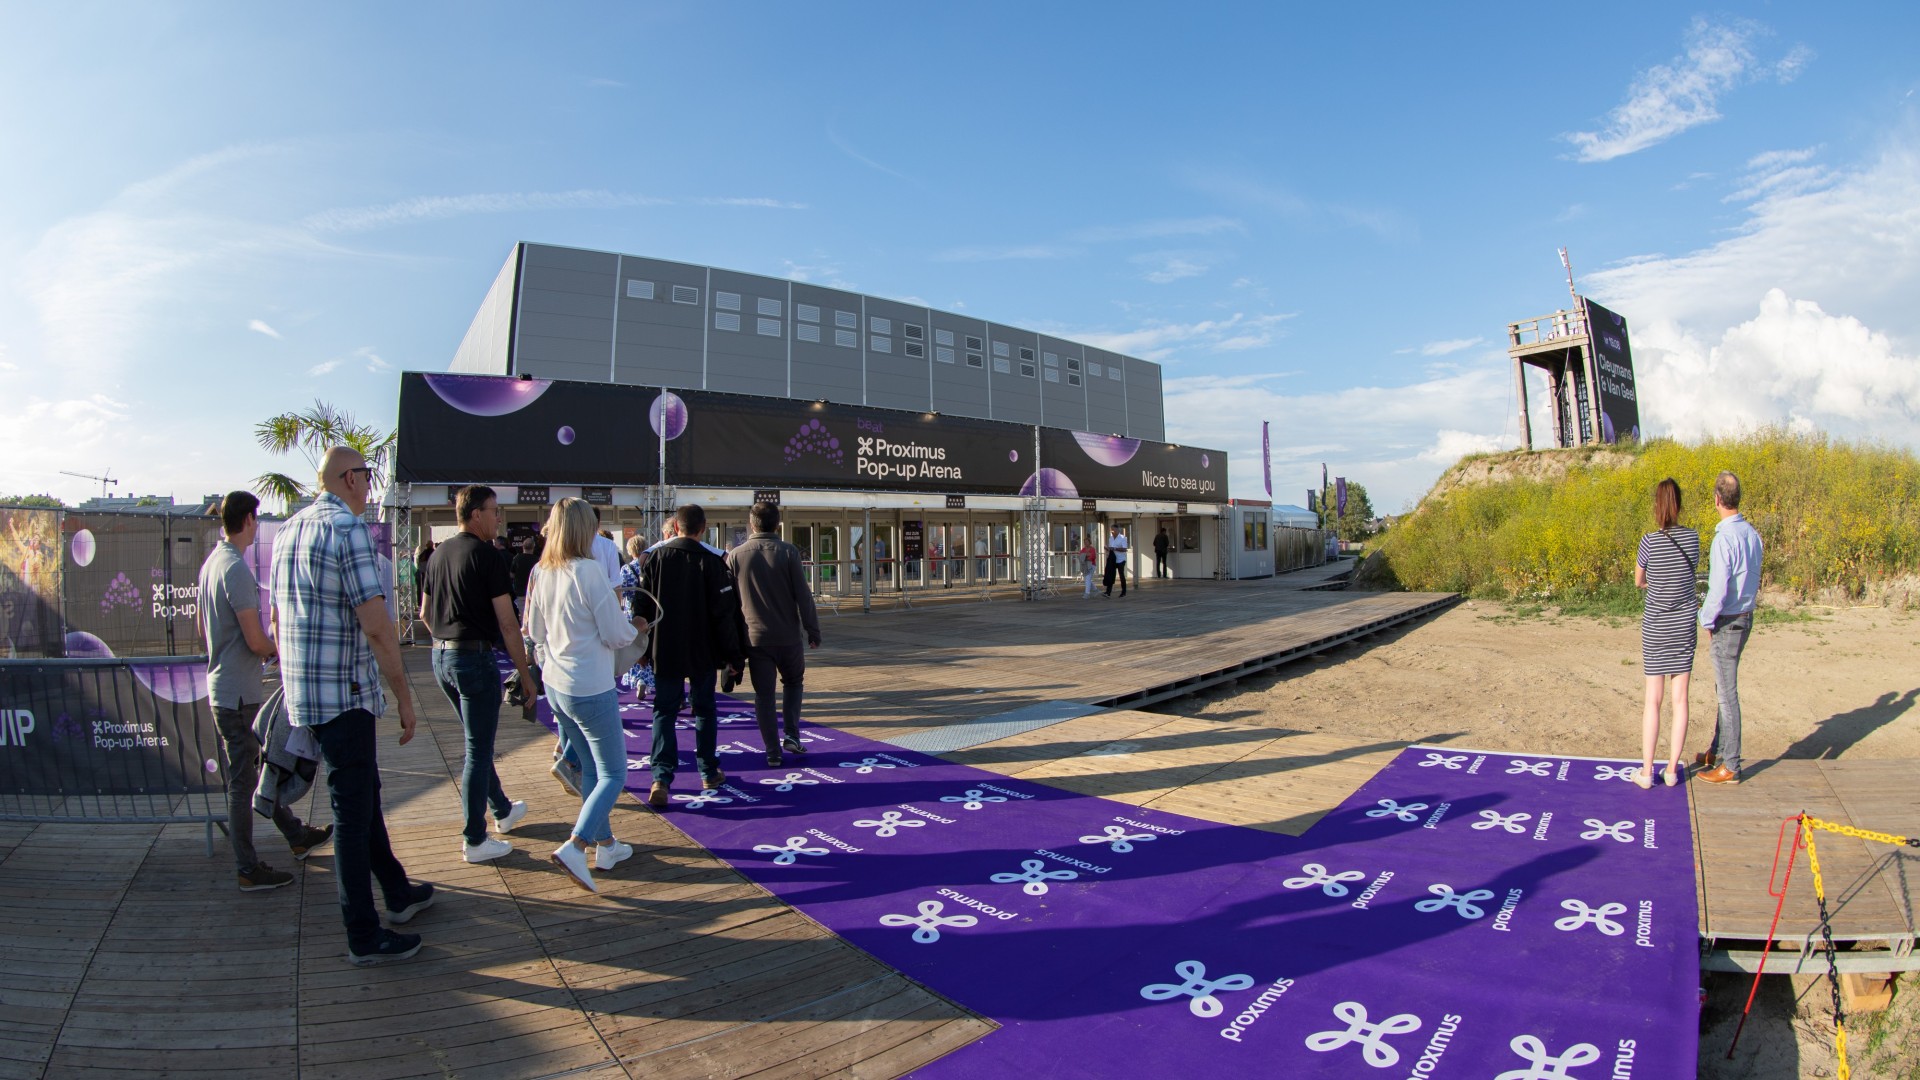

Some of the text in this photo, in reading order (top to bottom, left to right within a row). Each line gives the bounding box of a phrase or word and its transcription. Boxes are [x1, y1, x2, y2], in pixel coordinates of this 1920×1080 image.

[1599, 354, 1632, 380] Cleymans
[1600, 375, 1606, 392] &
[1607, 377, 1620, 396] Van
[857, 418, 884, 432] beat
[876, 438, 946, 460] Proximus
[857, 457, 962, 481] Pop-up Arena
[1142, 470, 1216, 494] Nice to sea you
[152, 602, 196, 620] Pop-up
[104, 720, 154, 734] Proximus
[94, 735, 168, 750] Pop-up Arena
[977, 782, 1035, 800] proximus
[898, 804, 957, 824] proximus
[1113, 816, 1186, 836] proximus
[1533, 812, 1554, 841] proximus
[1644, 818, 1658, 849] proximus
[806, 828, 864, 853] proximus
[1034, 848, 1112, 874] proximus
[1352, 870, 1394, 910] proximus
[936, 888, 1018, 920] proximus
[1492, 888, 1522, 932] proximus
[1636, 900, 1654, 947] proximus
[1220, 977, 1294, 1042] proximus
